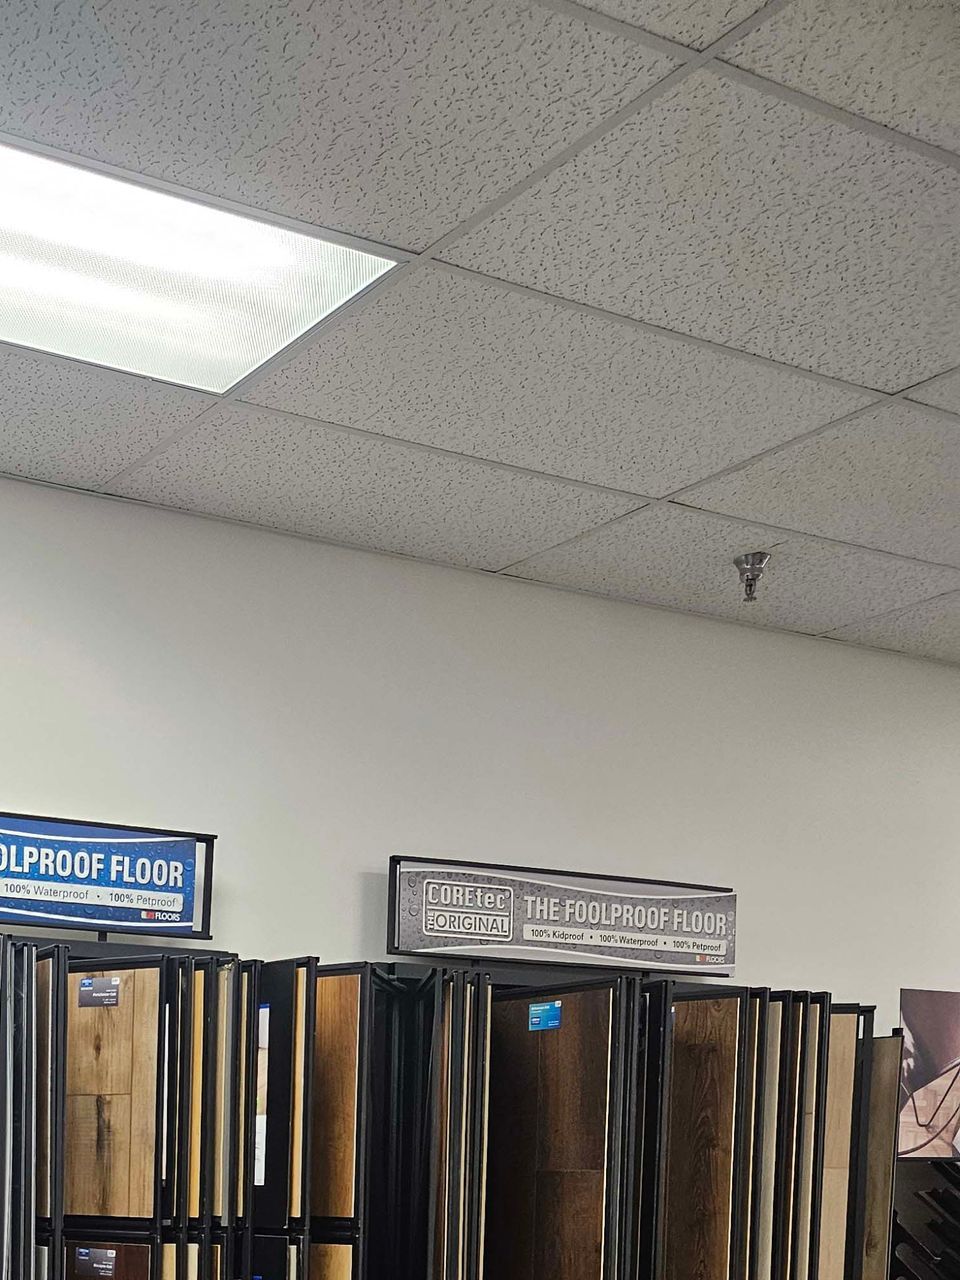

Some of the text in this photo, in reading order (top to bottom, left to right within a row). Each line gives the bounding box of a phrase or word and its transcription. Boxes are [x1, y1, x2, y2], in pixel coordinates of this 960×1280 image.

[110, 854, 185, 888] FLOOR
[4, 883, 31, 896] 100%
[33, 885, 89, 901] Waterproof
[109, 892, 134, 904] 100%
[136, 894, 177, 908] Petproof
[427, 910, 435, 930] THE
[435, 913, 507, 934] ORIGINAL
[524, 895, 727, 935] THE FOOLPROOF FLOOR
[531, 929, 722, 953] 100% Kidproof 100% Waterproof 100% Petproof
